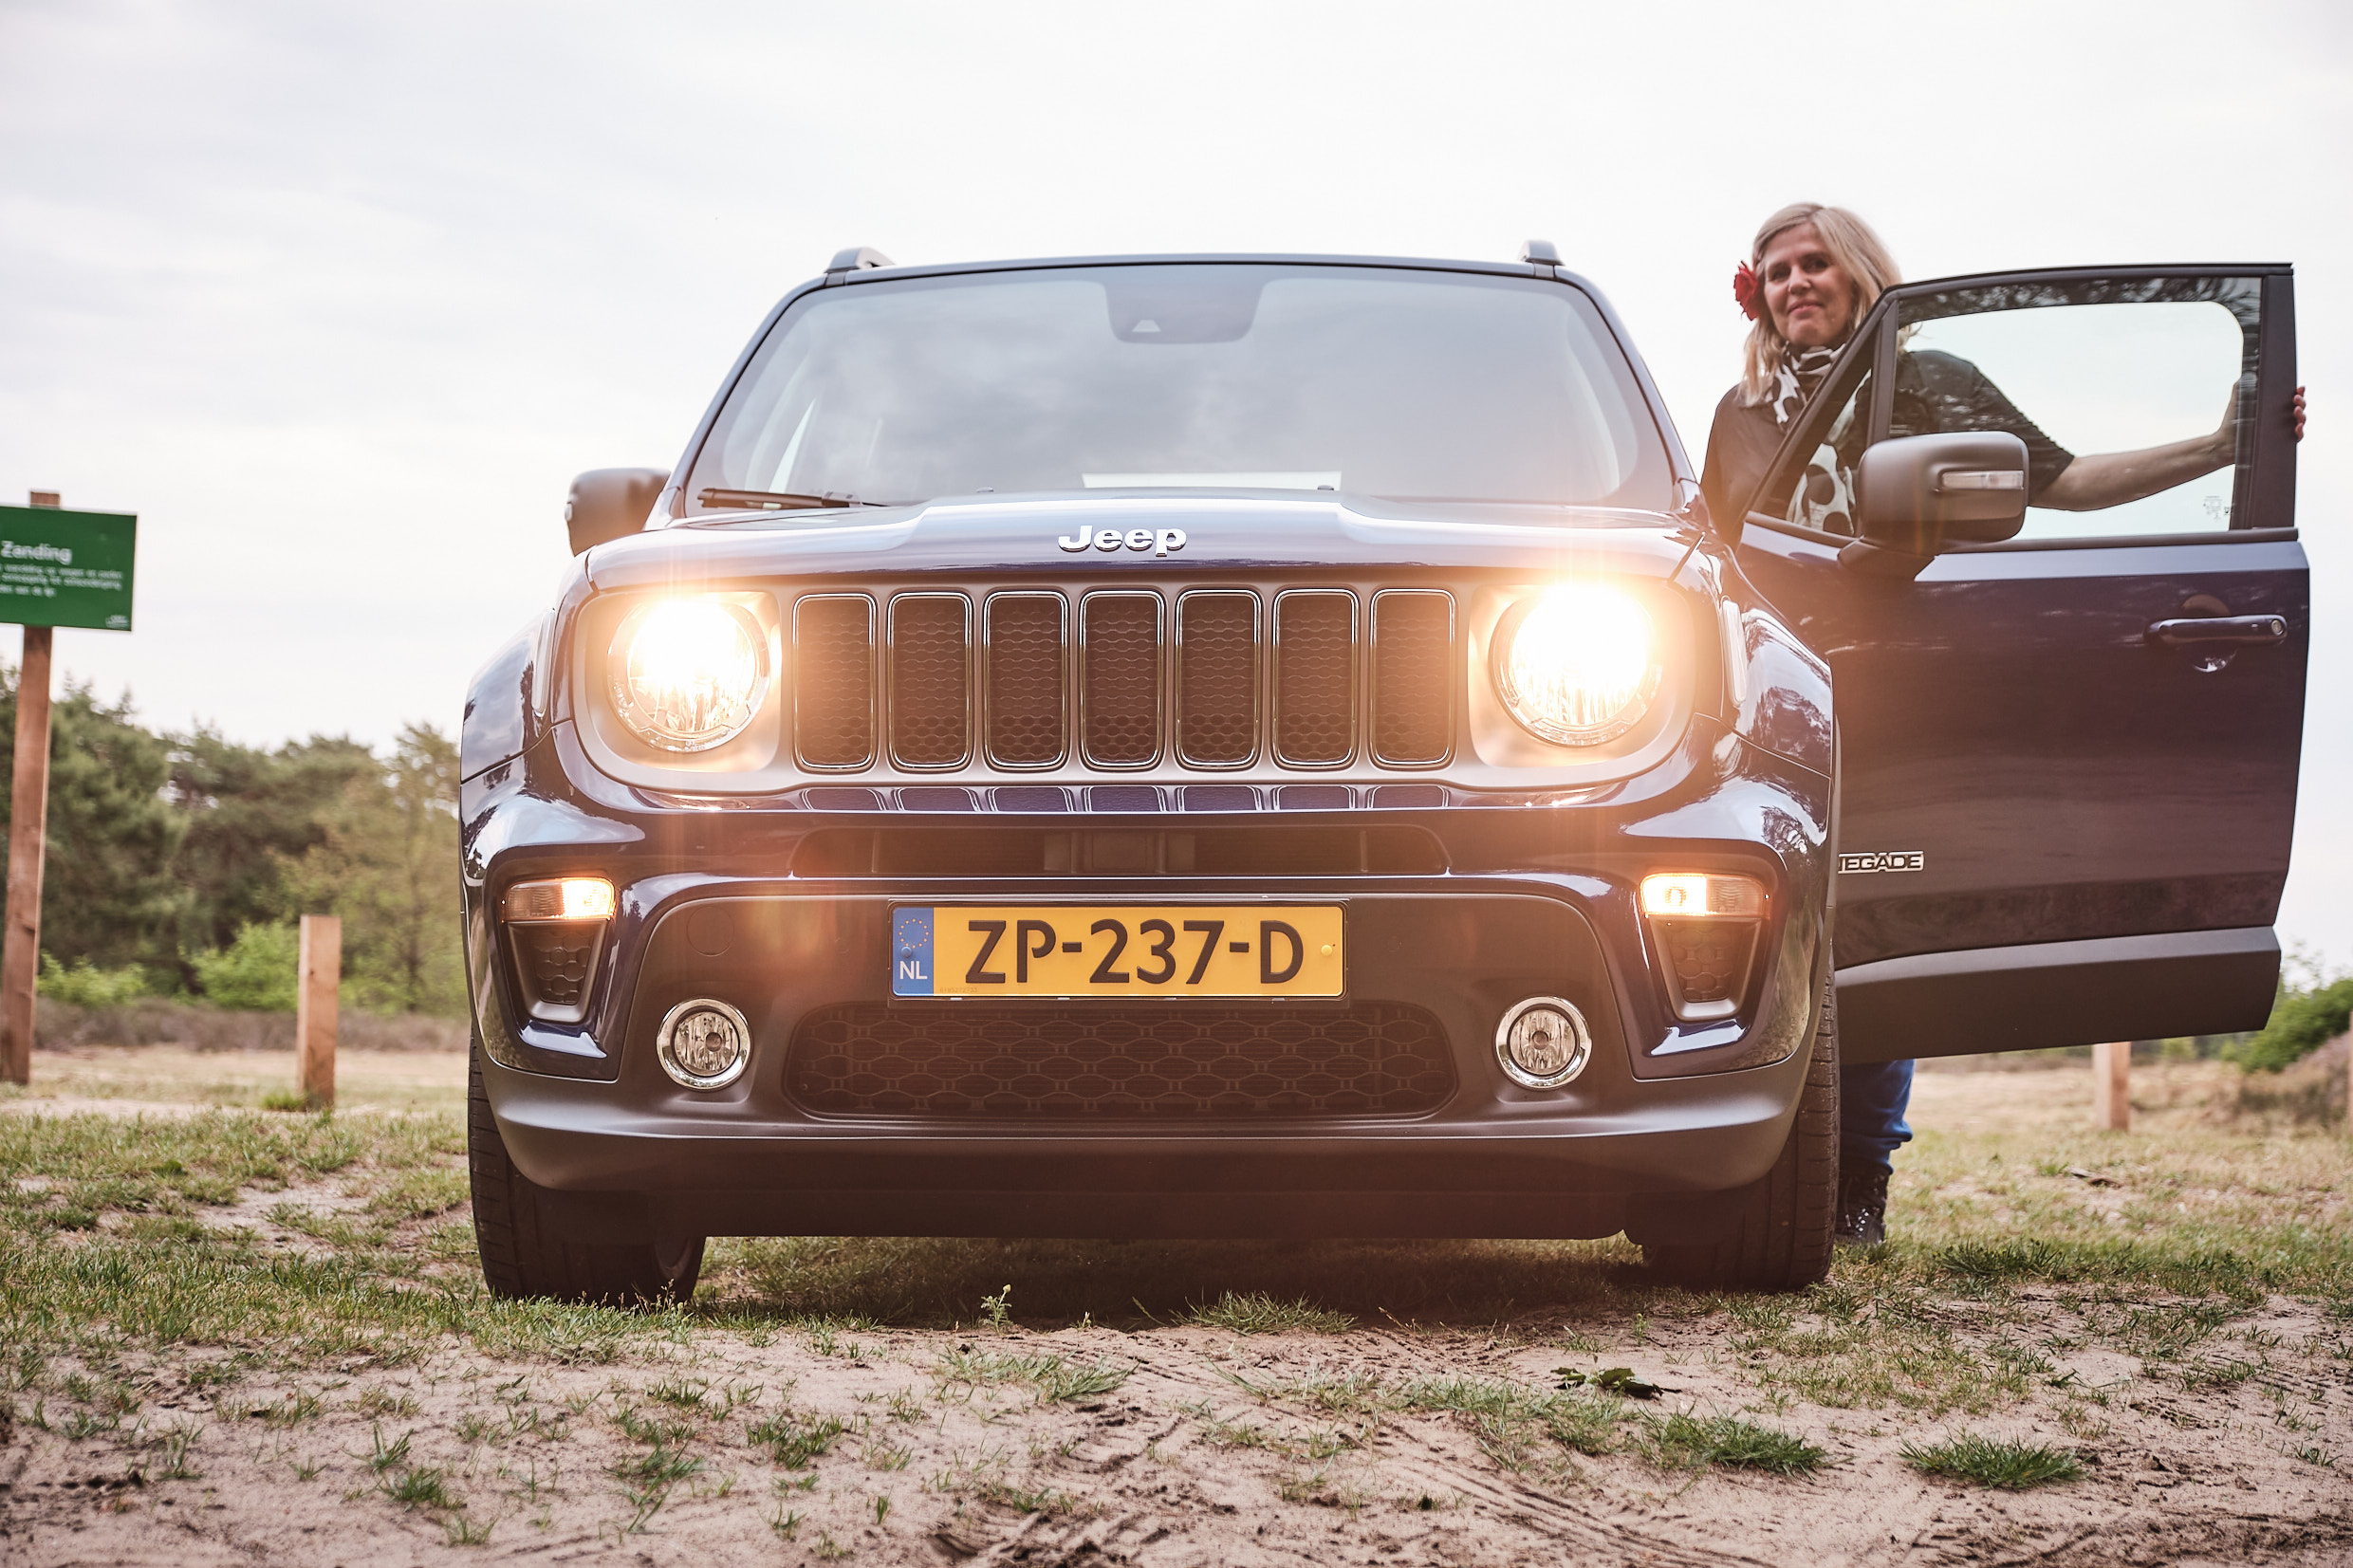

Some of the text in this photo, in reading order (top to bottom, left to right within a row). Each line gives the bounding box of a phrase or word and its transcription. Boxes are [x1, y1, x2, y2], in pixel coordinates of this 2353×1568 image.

[1058, 525, 1187, 558] Jeep
[1839, 851, 1924, 874] EGADE
[965, 918, 1304, 985] ZP-237-D
[899, 960, 928, 980] NL
